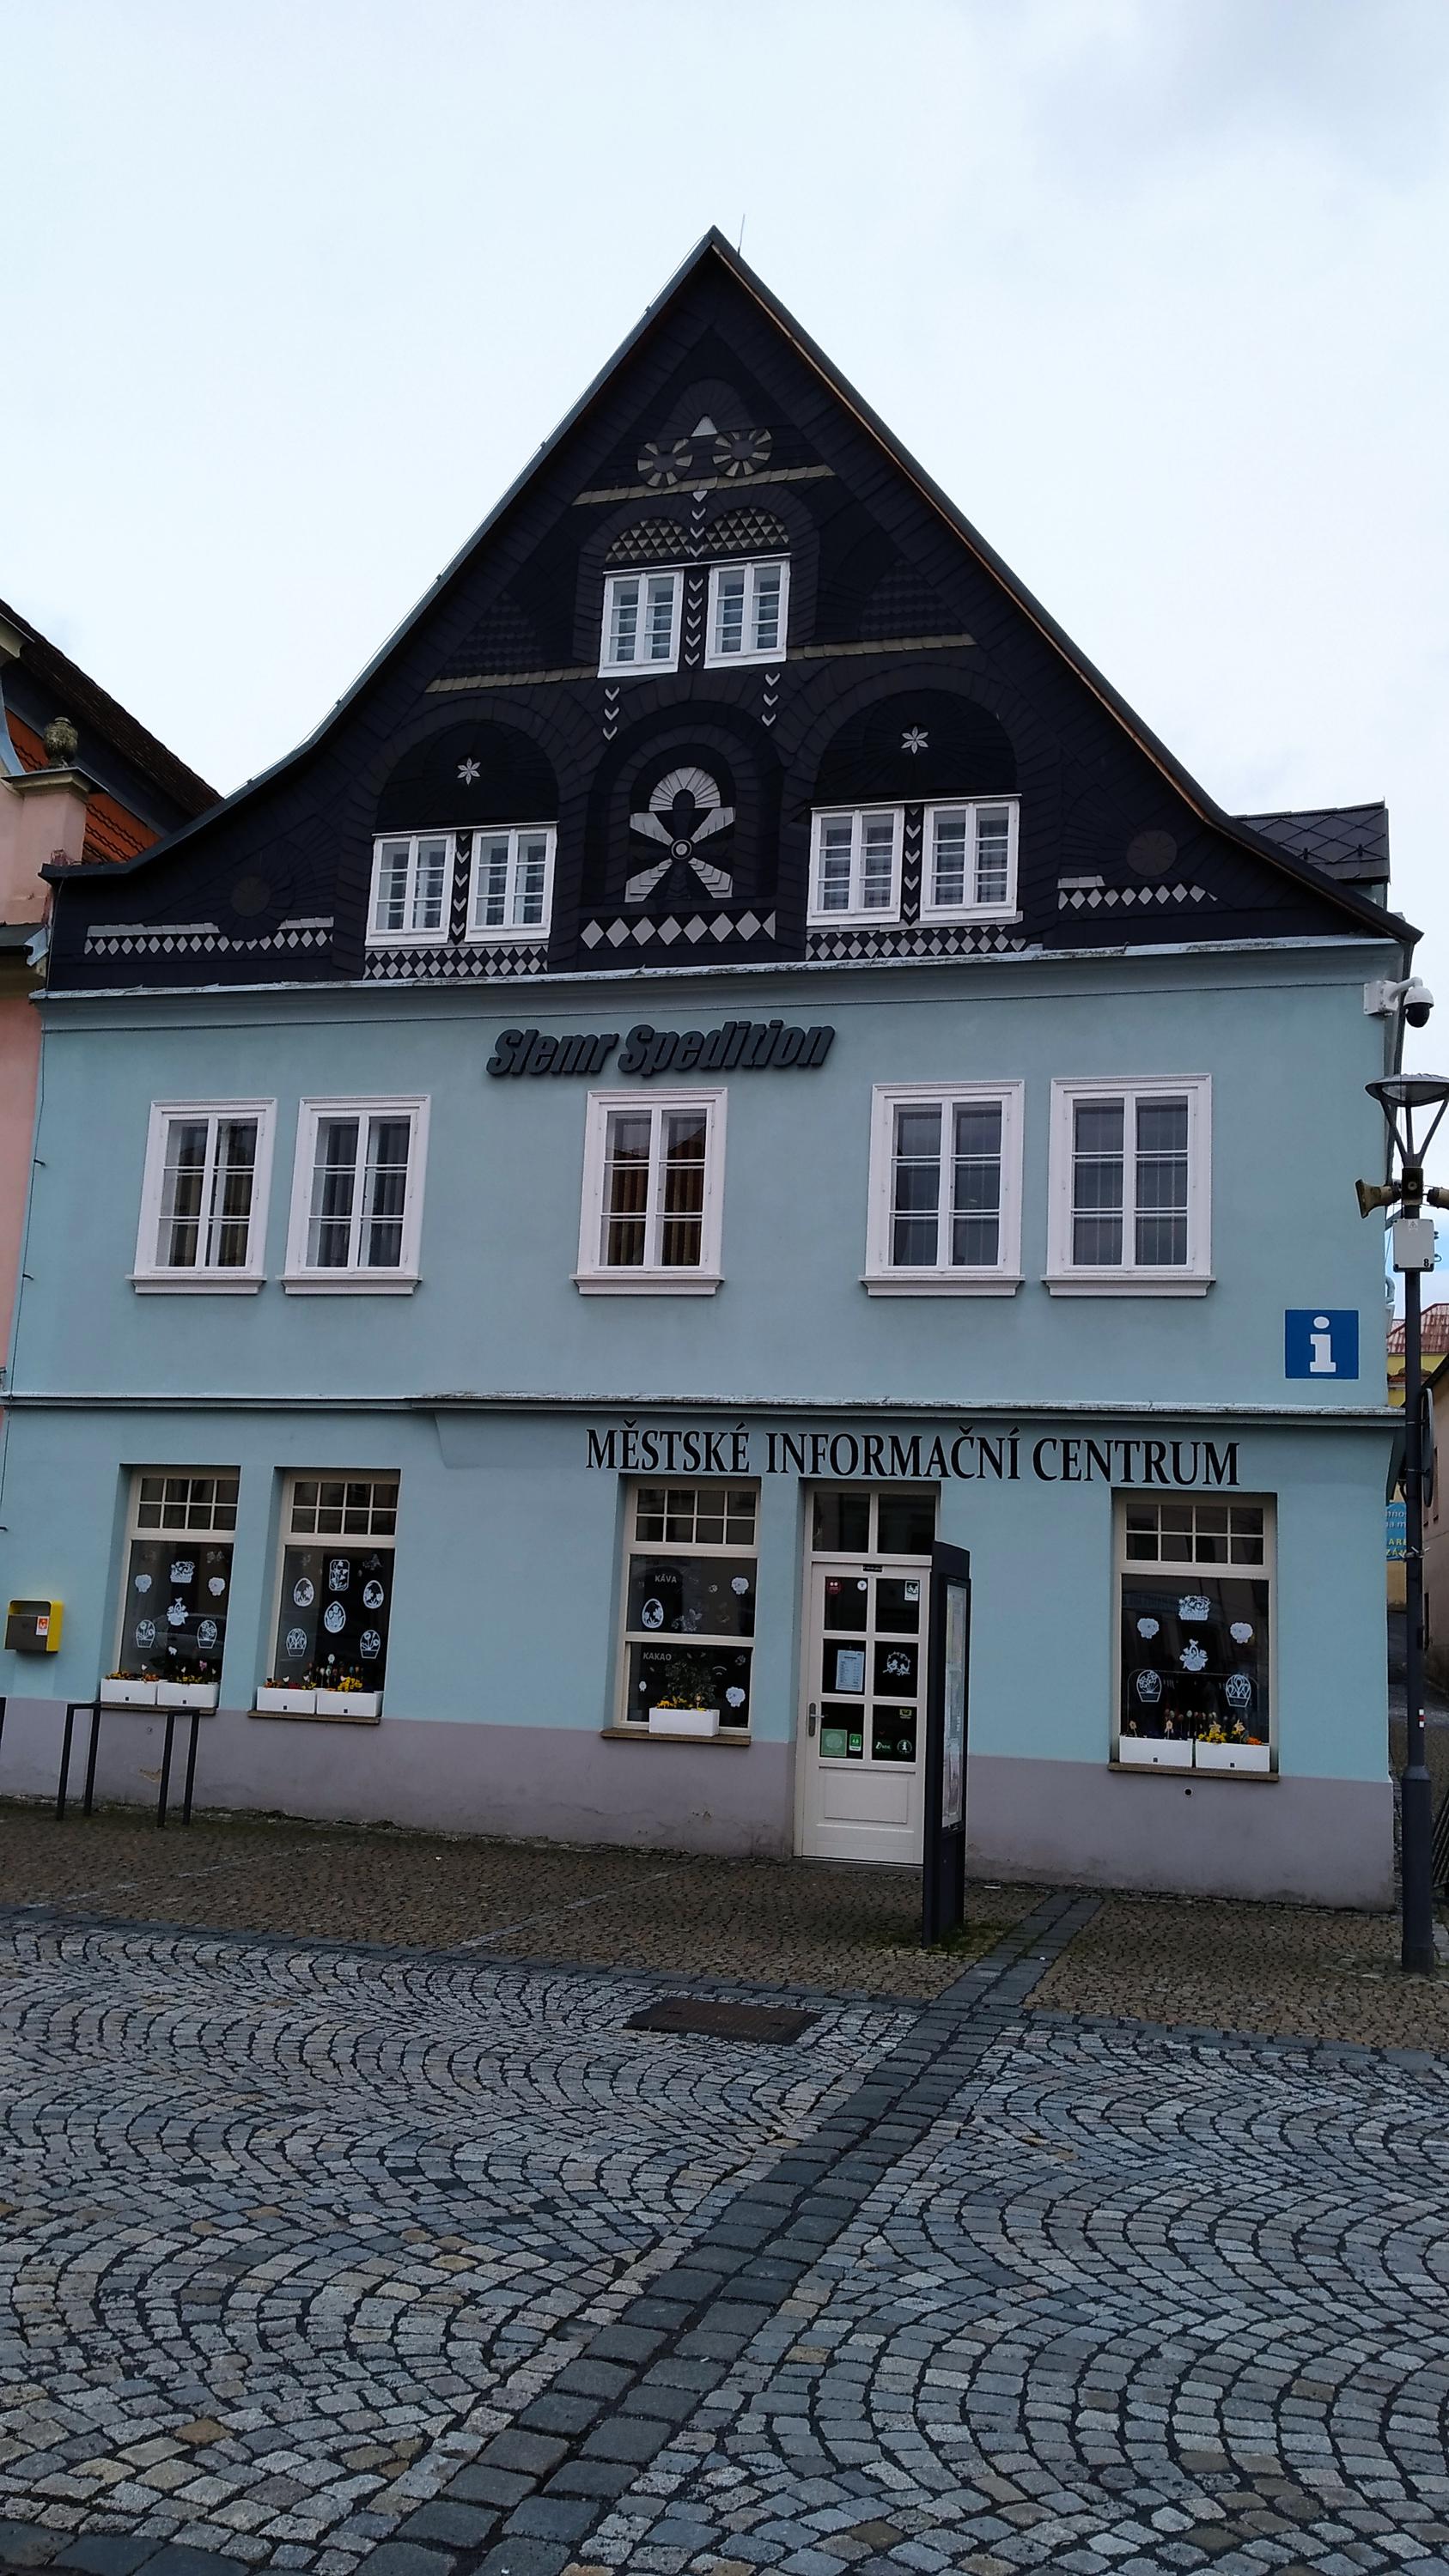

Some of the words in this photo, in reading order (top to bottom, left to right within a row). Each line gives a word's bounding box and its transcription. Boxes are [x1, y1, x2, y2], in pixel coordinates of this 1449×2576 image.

[618, 1019, 835, 1076] Spedition
[1423, 1258, 1429, 1267] 8
[586, 1419, 750, 1473] MĚSTSKÉ
[765, 1425, 1021, 1480] INFORMAČNÍ
[1032, 1437, 1240, 1486] CENTRUM
[654, 1574, 677, 1583] KÁVA
[642, 1651, 672, 1661] KAKAO
